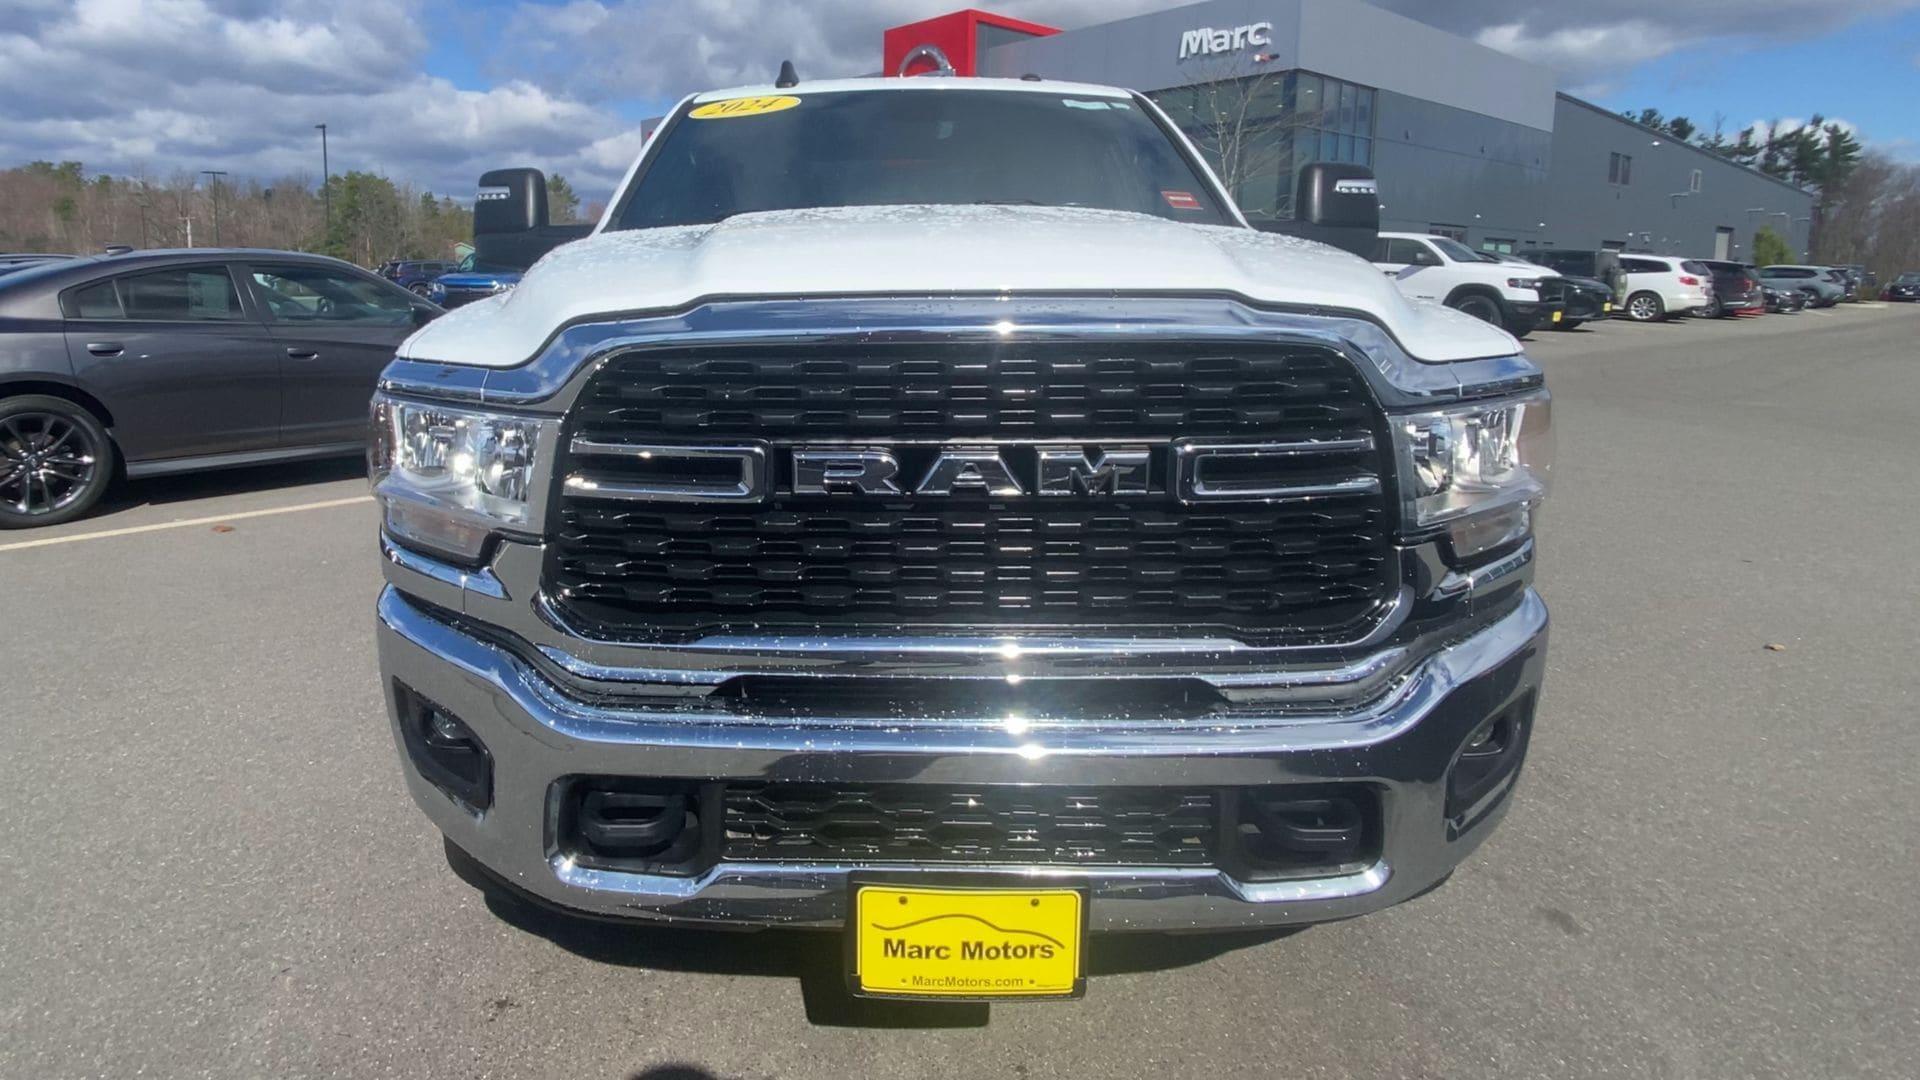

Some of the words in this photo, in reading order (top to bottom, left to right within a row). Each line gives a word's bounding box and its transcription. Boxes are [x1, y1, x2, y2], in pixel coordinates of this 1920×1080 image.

[1179, 22, 1272, 59] Marc
[792, 447, 1152, 496] RAM
[883, 938, 950, 960] Marc
[960, 940, 1055, 960] Motors
[911, 975, 1024, 987] MarcMotors.com
